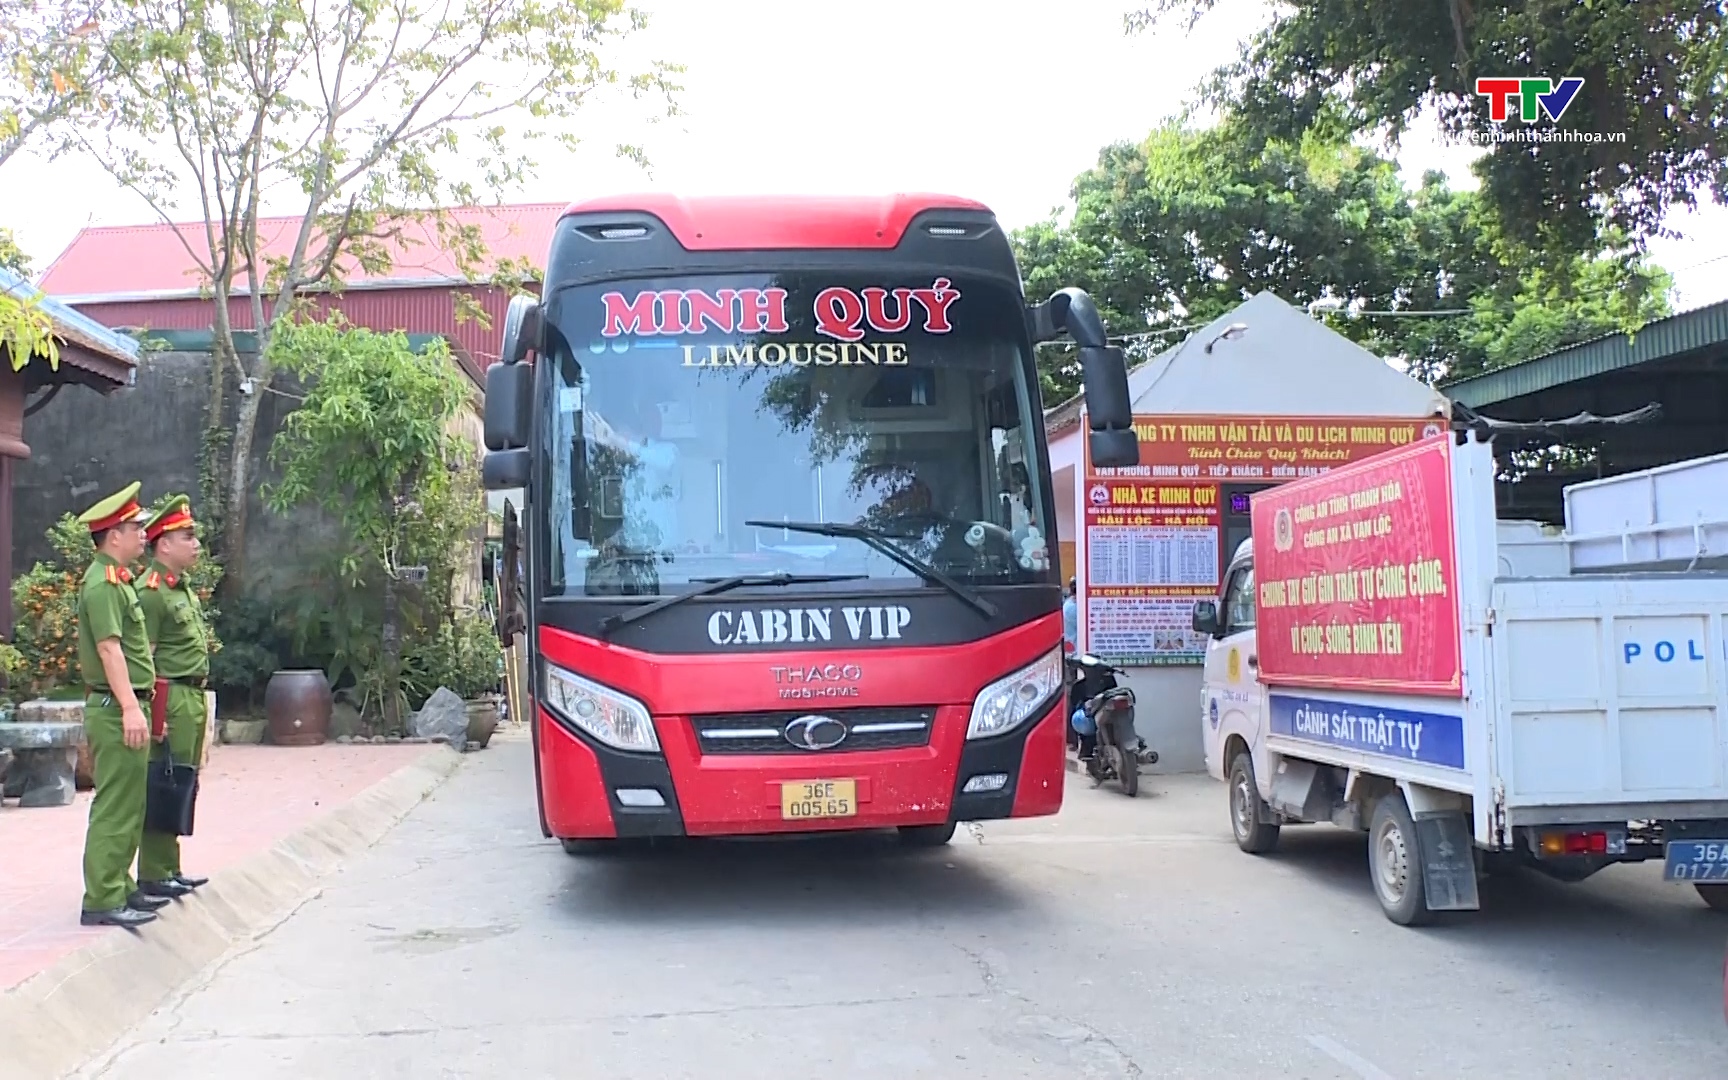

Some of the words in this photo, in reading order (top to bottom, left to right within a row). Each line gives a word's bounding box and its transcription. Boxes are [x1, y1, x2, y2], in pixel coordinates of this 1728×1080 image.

[601, 290, 789, 336] MINH
[814, 277, 961, 341] QUÝ
[680, 343, 909, 368] LIMOUSINE
[1132, 422, 1157, 442] NG
[1160, 424, 1177, 442] TY
[1180, 424, 1216, 442] TNHH
[1220, 421, 1247, 446] VẬN
[1250, 419, 1271, 442] TẢI
[1275, 422, 1293, 442] VÀ
[1296, 426, 1313, 442] DU
[1318, 426, 1347, 446] LỊCH
[1351, 426, 1386, 443] MINH
[1389, 423, 1415, 445] QUÝ
[1188, 446, 1222, 459] Kính
[1226, 445, 1263, 459] Chào
[1267, 447, 1297, 462] Quý
[1301, 447, 1350, 461] Khách!
[1152, 465, 1179, 476] MINH
[1181, 464, 1200, 477] QUÝ
[1208, 463, 1230, 476] TIẾP
[1231, 464, 1263, 476] KHÁCH
[1112, 484, 1138, 504] NHÀ
[1140, 487, 1157, 504] XE
[1159, 487, 1191, 504] MINH
[1193, 485, 1217, 506] QUÝ
[1294, 503, 1315, 524] CÔNG
[1316, 501, 1328, 518] AN
[1350, 487, 1380, 511] THANH
[1381, 479, 1402, 504] HÓA
[1304, 530, 1326, 548] CÔNG
[1326, 527, 1338, 544] AN
[1374, 513, 1392, 538] LỘC
[1260, 580, 1286, 608] CHUNG
[1287, 578, 1300, 606] TAY
[1335, 565, 1359, 608] TRẬT
[1360, 570, 1374, 606] TỰ
[1376, 560, 1406, 600] CÔNG
[1408, 554, 1446, 603] CỘNG,
[708, 608, 832, 645] CABIN
[841, 605, 912, 640] VIP
[1301, 618, 1324, 660] CUỘC
[1326, 615, 1352, 654] SỐNG
[1352, 617, 1378, 654] BÌNH
[1380, 615, 1403, 654] YÊN
[770, 664, 862, 684] THACO
[778, 686, 860, 699] MOBIHOME
[1296, 704, 1330, 736] CẢNH
[1332, 710, 1355, 742] SÁT
[1359, 712, 1396, 750] TRẬT
[1398, 720, 1422, 758] TỰ
[803, 783, 835, 800] 36E
[790, 800, 848, 816] 005.65
[1692, 844, 1728, 862] 36A
